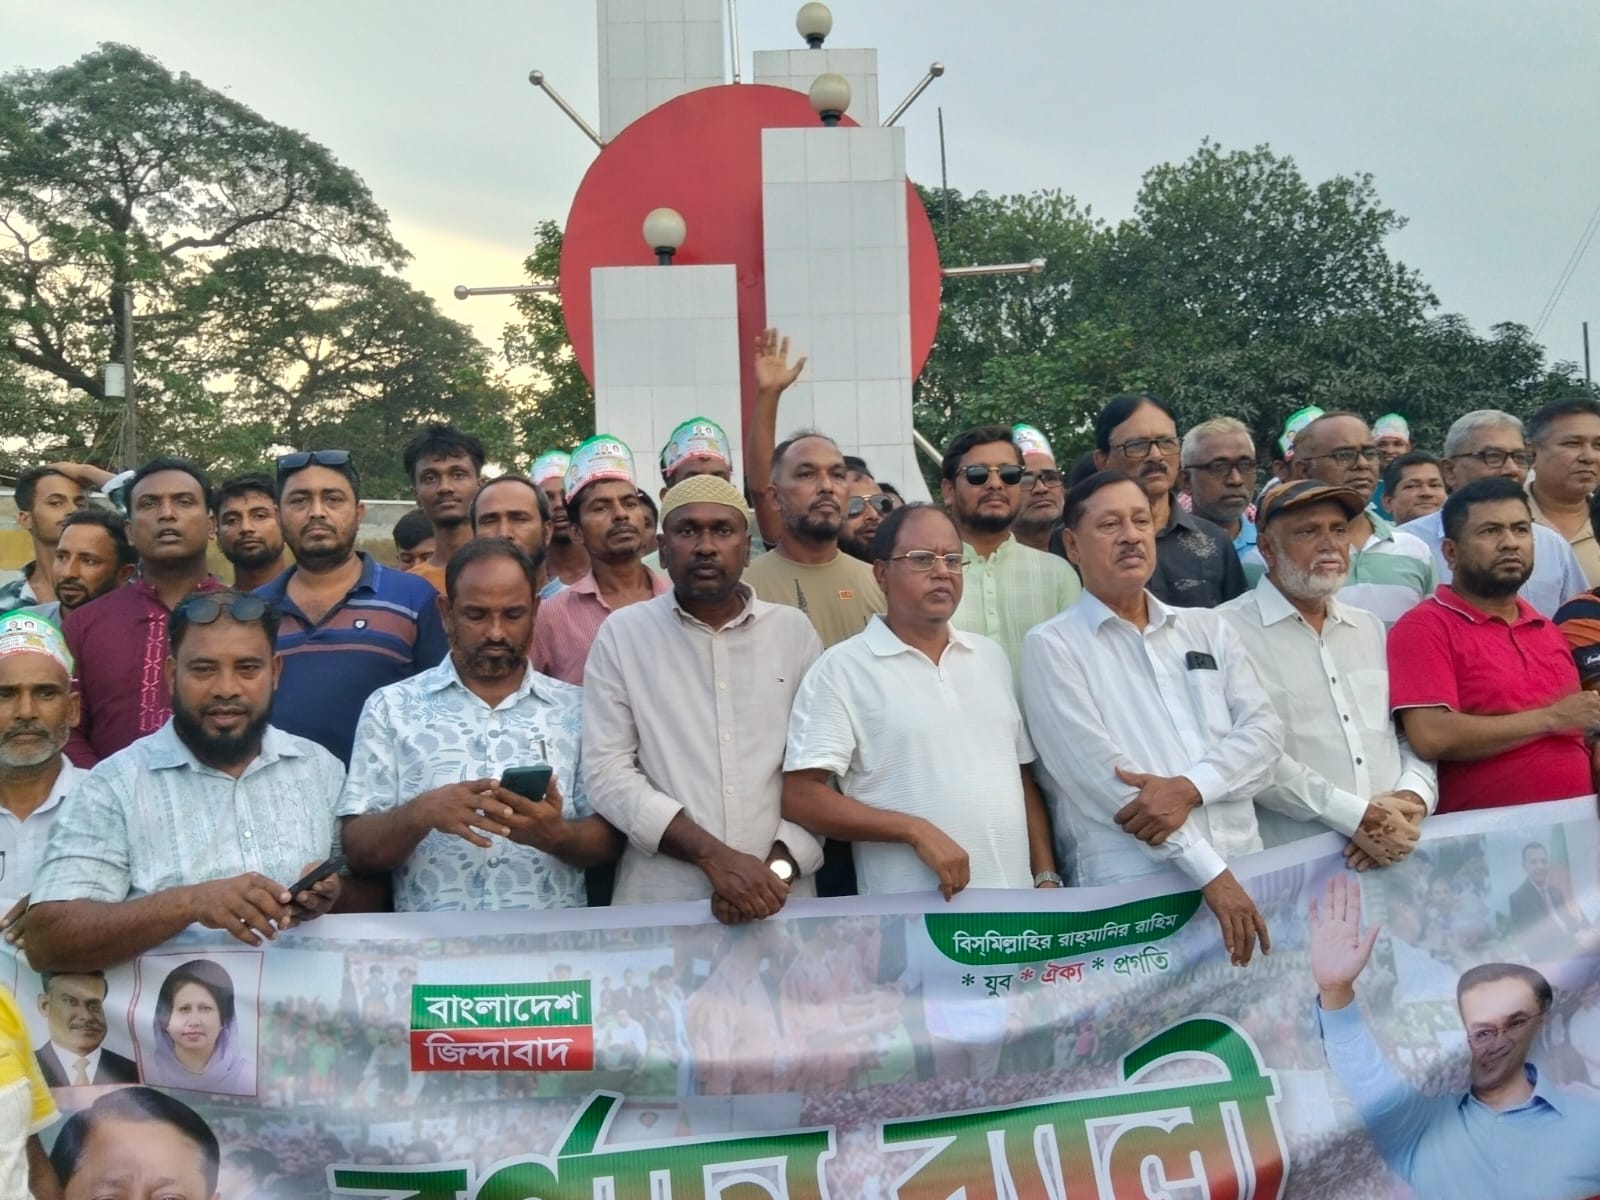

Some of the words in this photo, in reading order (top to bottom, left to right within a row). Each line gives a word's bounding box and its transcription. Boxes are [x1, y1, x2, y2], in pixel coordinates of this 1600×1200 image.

[1134, 912, 1179, 934] রাহিম
[983, 974, 1014, 997] যুব
[1041, 961, 1085, 985] ঐক্য
[1113, 945, 1169, 976] প্রগতি
[424, 991, 584, 1025] বাংলাদেশ
[422, 1032, 574, 1067] জিন্দাবাদ
